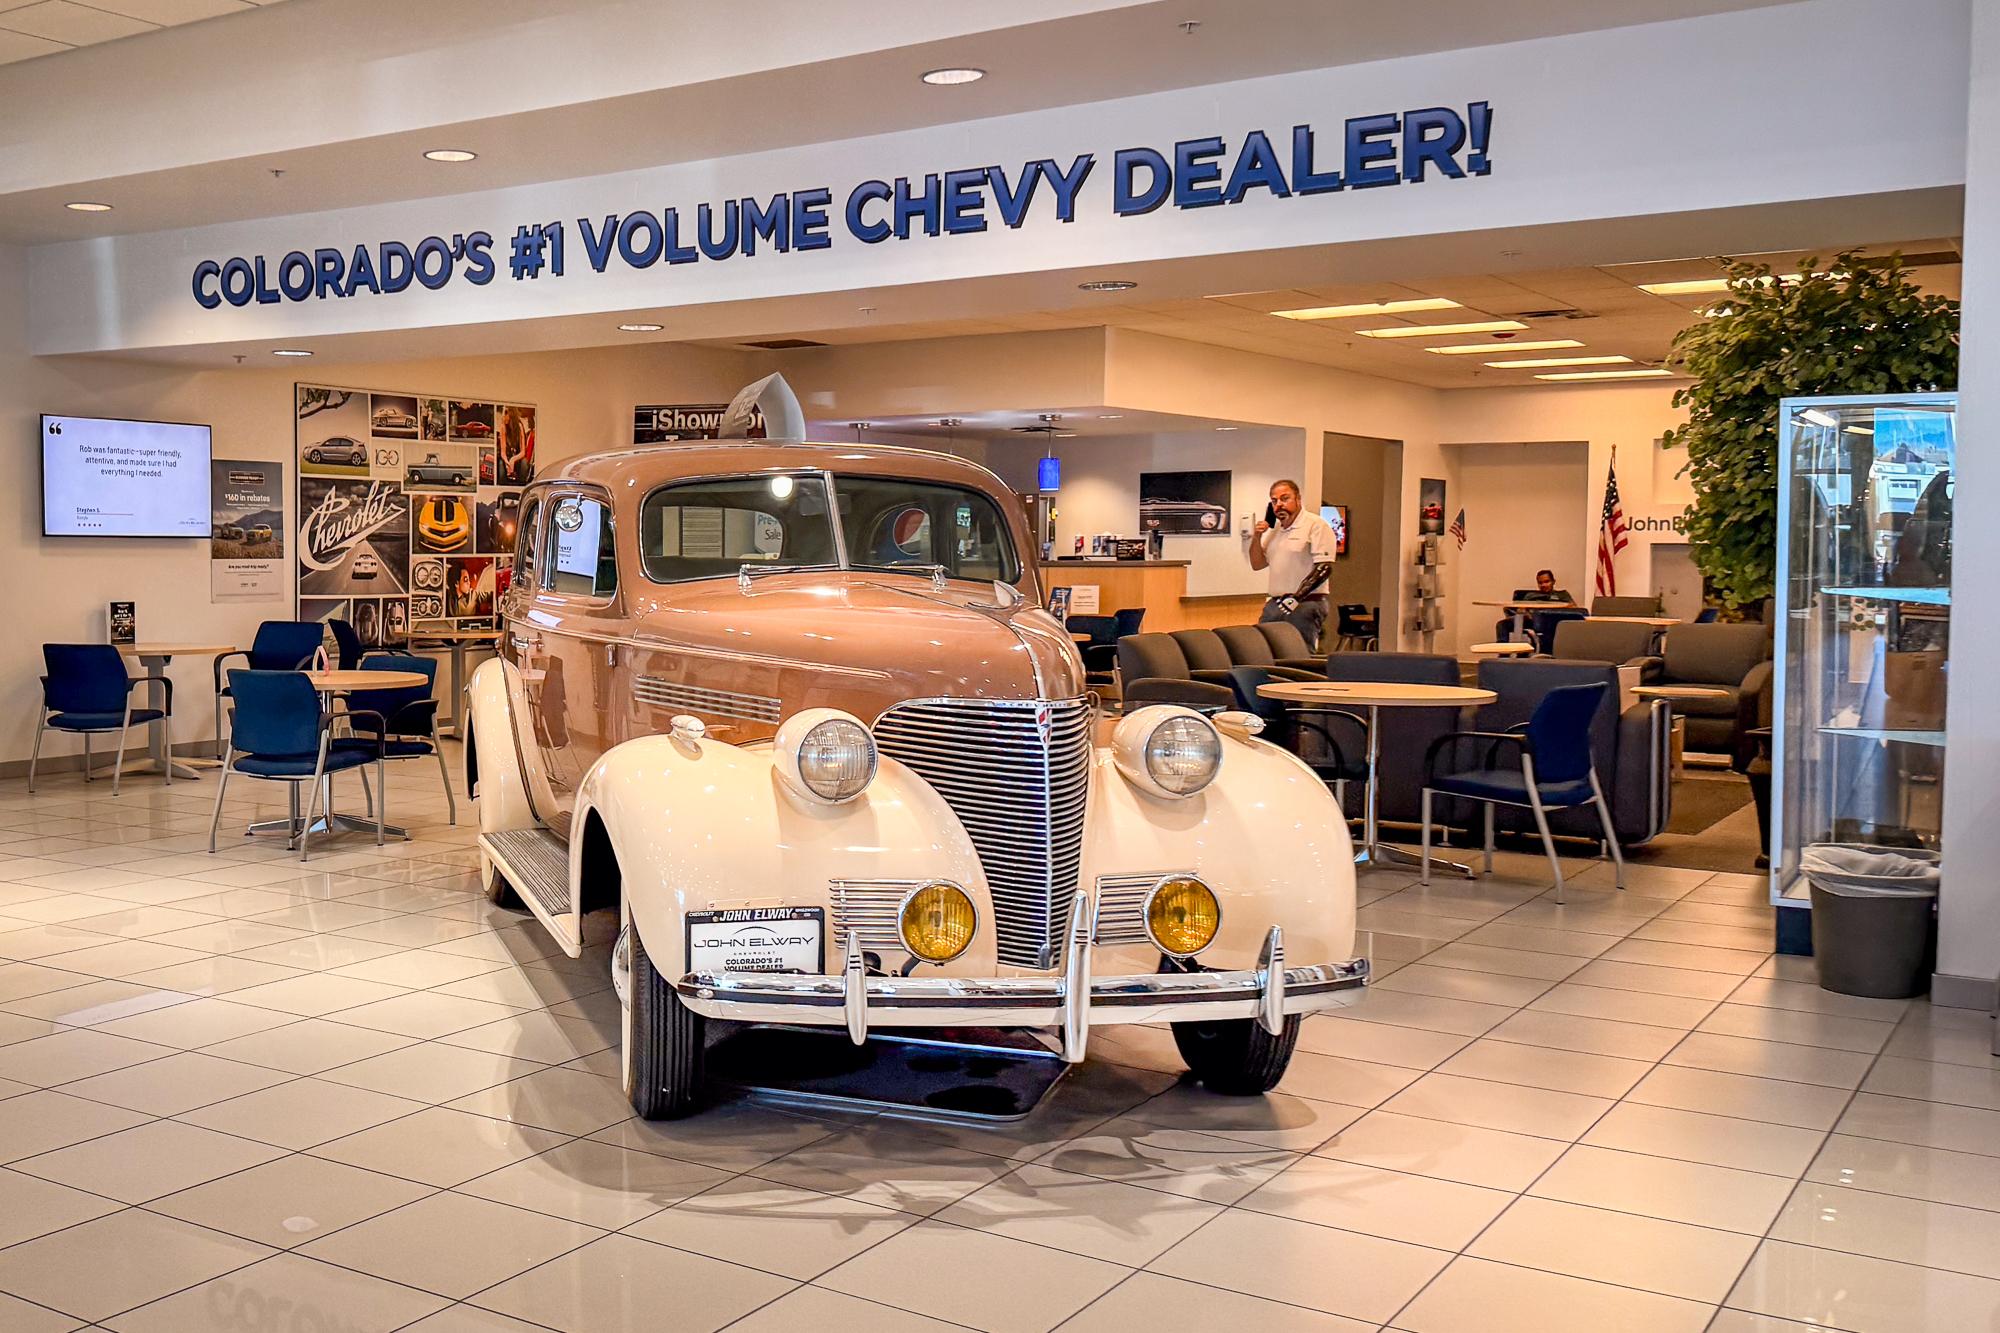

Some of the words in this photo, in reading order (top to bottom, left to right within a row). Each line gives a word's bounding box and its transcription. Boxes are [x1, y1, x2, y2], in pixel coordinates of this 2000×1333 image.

[192, 231, 495, 309] COLORADO'S
[510, 221, 564, 280] #1
[577, 187, 832, 273] VOLUME
[845, 153, 1097, 244] CHEVY
[1114, 100, 1494, 217] DEALER!
[80, 445, 93, 453] Rob
[93, 446, 106, 454] was
[157, 449, 182, 459] friendly,
[85, 457, 116, 466] attentive,
[116, 458, 129, 466] and
[129, 458, 147, 467] made
[165, 460, 177, 468] had
[101, 468, 134, 478] everything
[247, 494, 270, 502] rebates
[300, 480, 406, 571] Chevrolet
[719, 909, 751, 922] JOHN
[754, 908, 794, 921] ELWAY
[693, 938, 746, 948] JOHN
[749, 936, 815, 947] ELWAY
[725, 957, 773, 965] COLORADO'S
